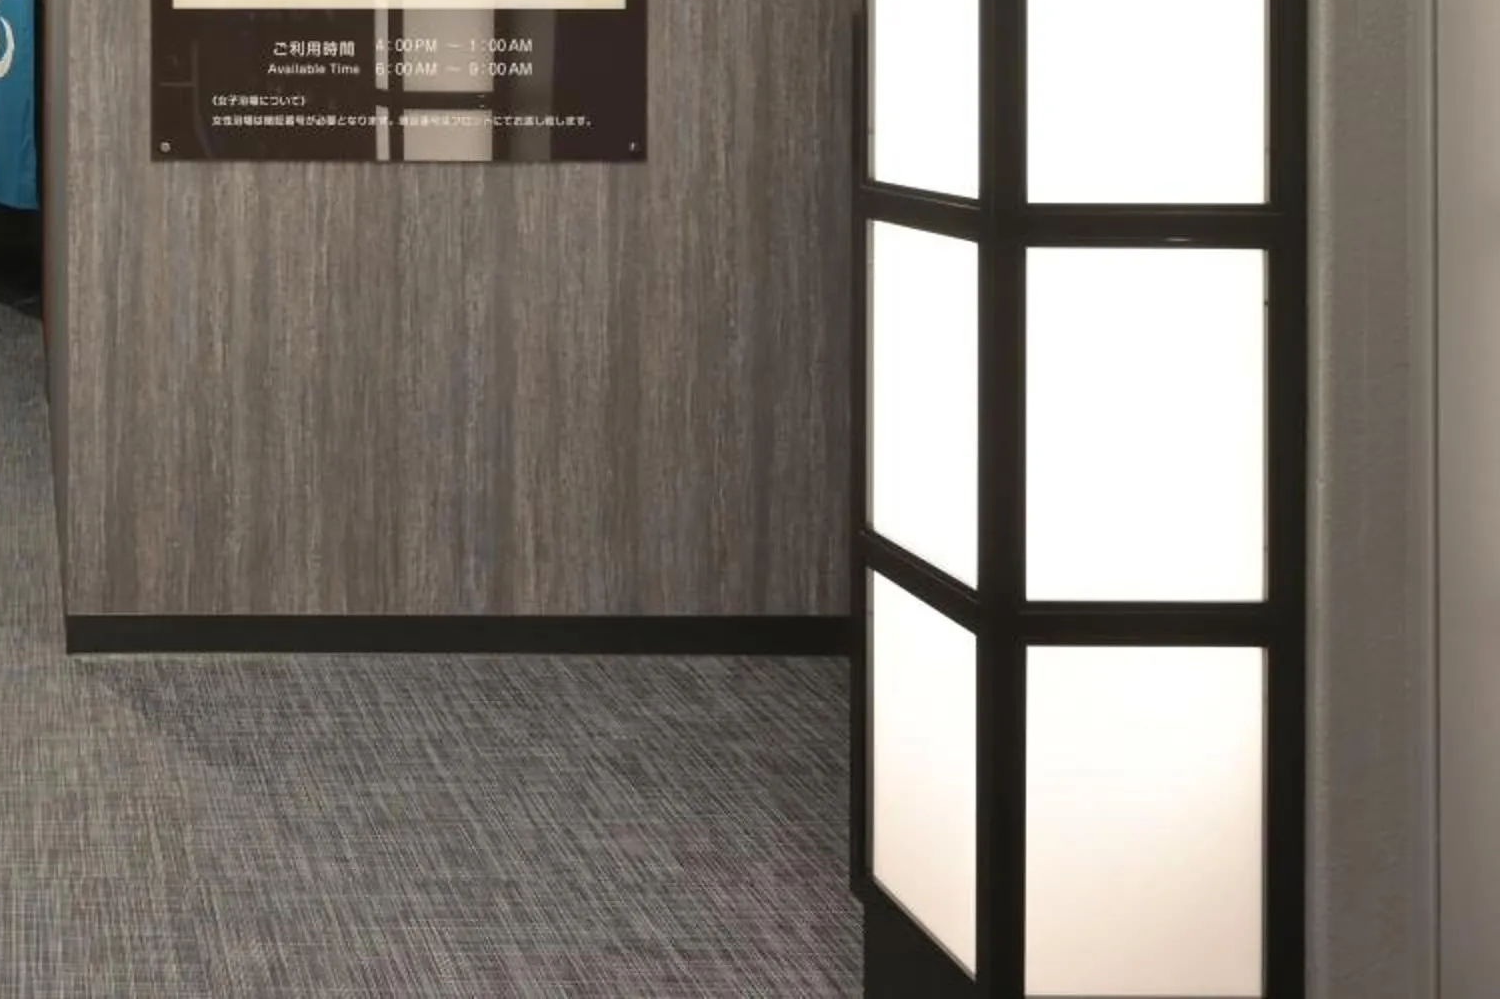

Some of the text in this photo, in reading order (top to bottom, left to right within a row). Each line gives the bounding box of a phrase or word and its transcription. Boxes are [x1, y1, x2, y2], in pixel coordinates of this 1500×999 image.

[273, 41, 355, 57] ご利用時間
[267, 63, 326, 74] Available
[330, 63, 360, 74] Time
